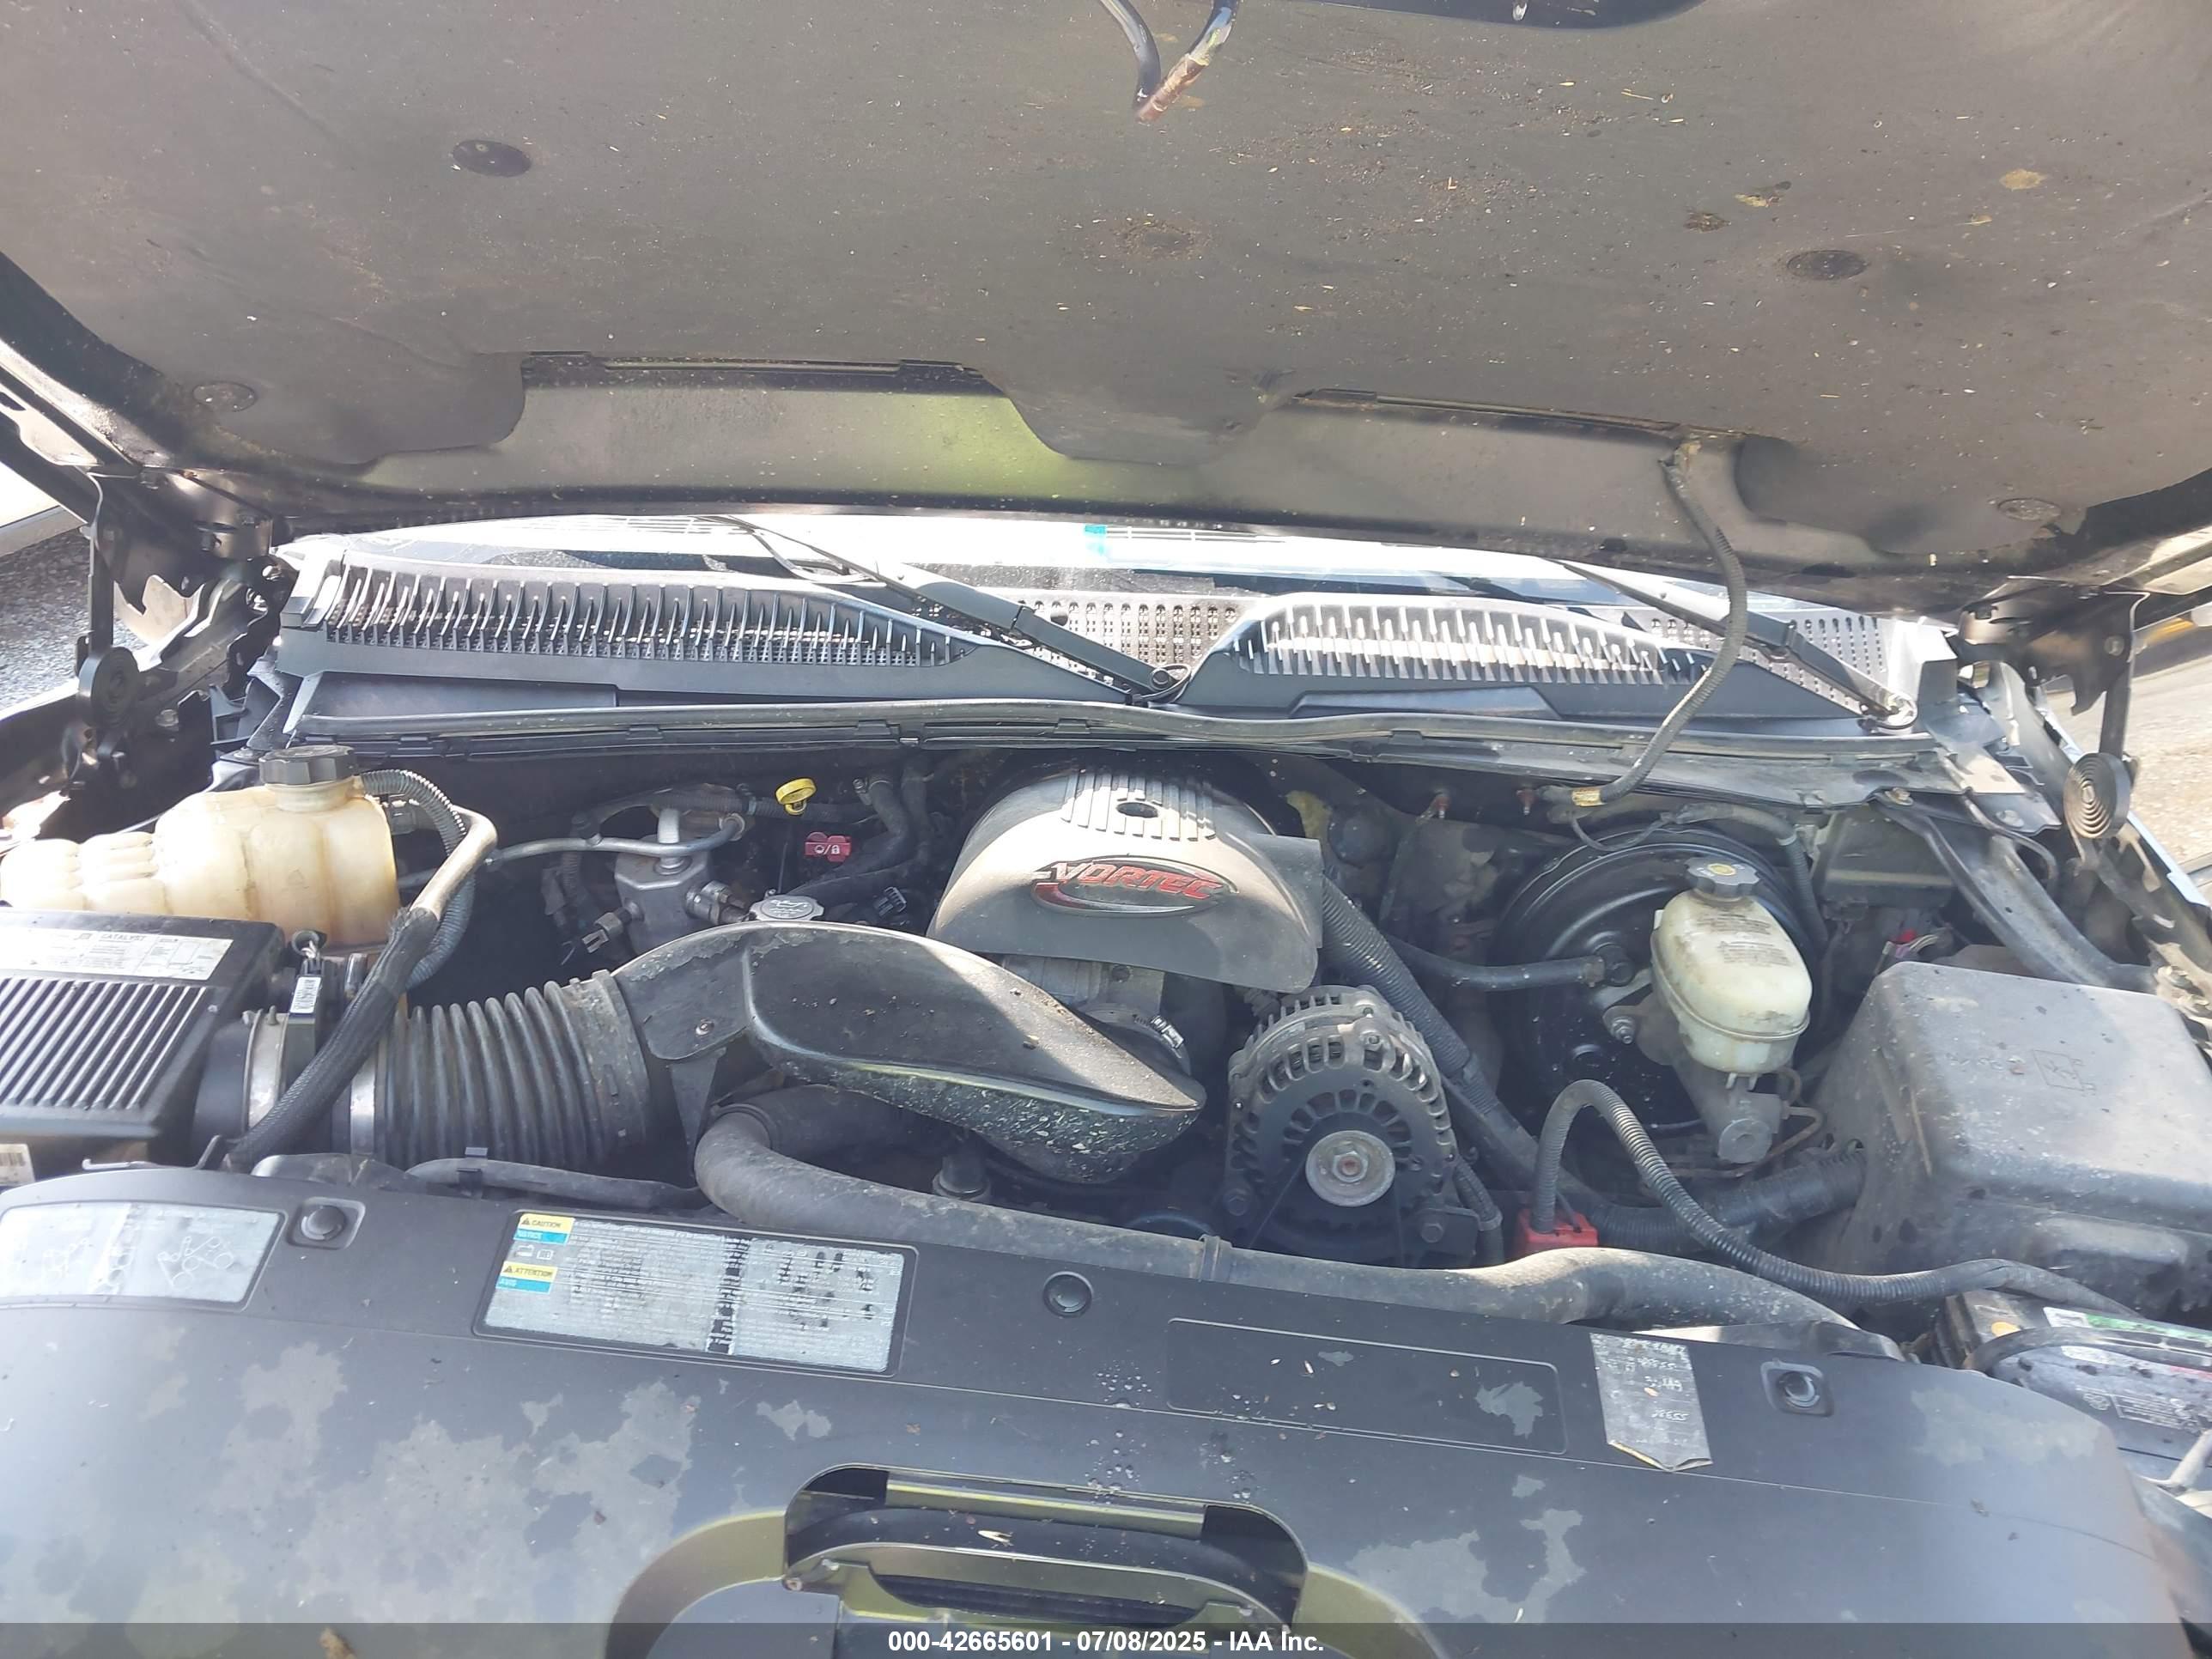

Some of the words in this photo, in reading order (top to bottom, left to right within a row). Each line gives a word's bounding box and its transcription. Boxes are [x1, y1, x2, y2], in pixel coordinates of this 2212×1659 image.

[1050, 862, 1224, 899] VORTEC
[531, 1220, 562, 1229] CAUTION
[514, 1267, 553, 1276] ATTENTION
